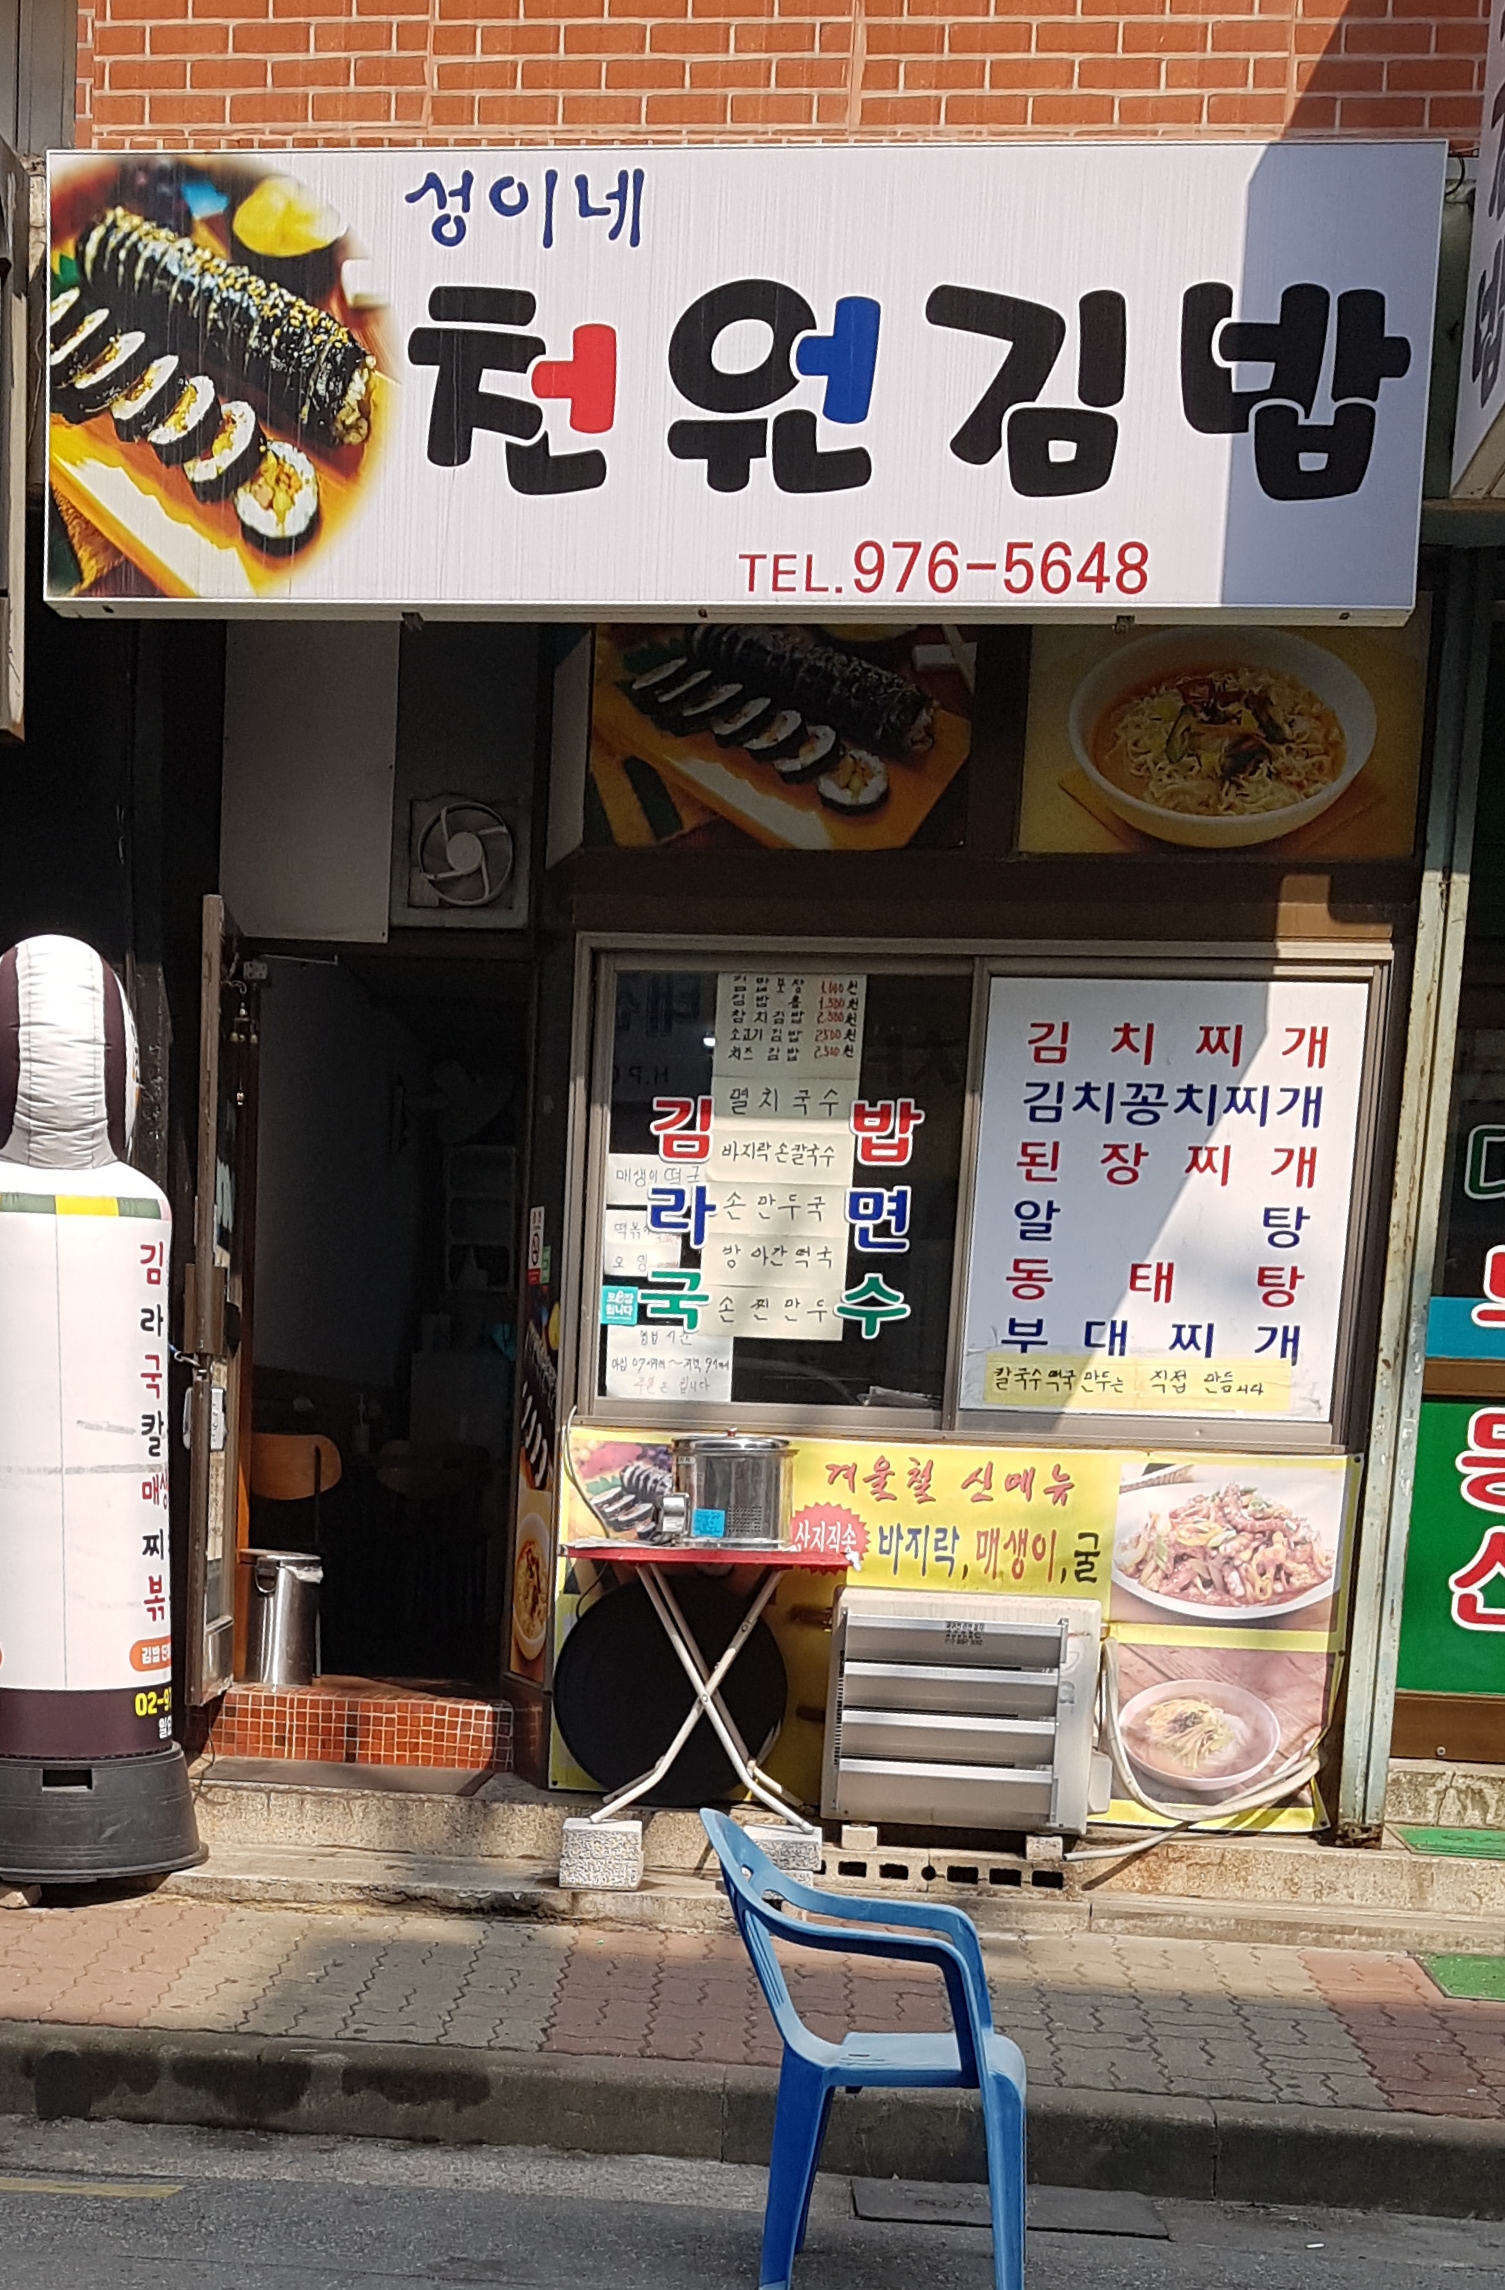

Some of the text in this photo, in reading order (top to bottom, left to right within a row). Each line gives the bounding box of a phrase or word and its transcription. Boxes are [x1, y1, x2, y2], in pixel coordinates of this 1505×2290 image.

[405, 168, 645, 248] 성이네
[1022, 1081, 1324, 1128] 김치꽁치찌개
[1149, 1369, 1187, 1395] 직접
[825, 1455, 1075, 1507] 겨울철 신메뉴
[1073, 1531, 1102, 1584] 굴
